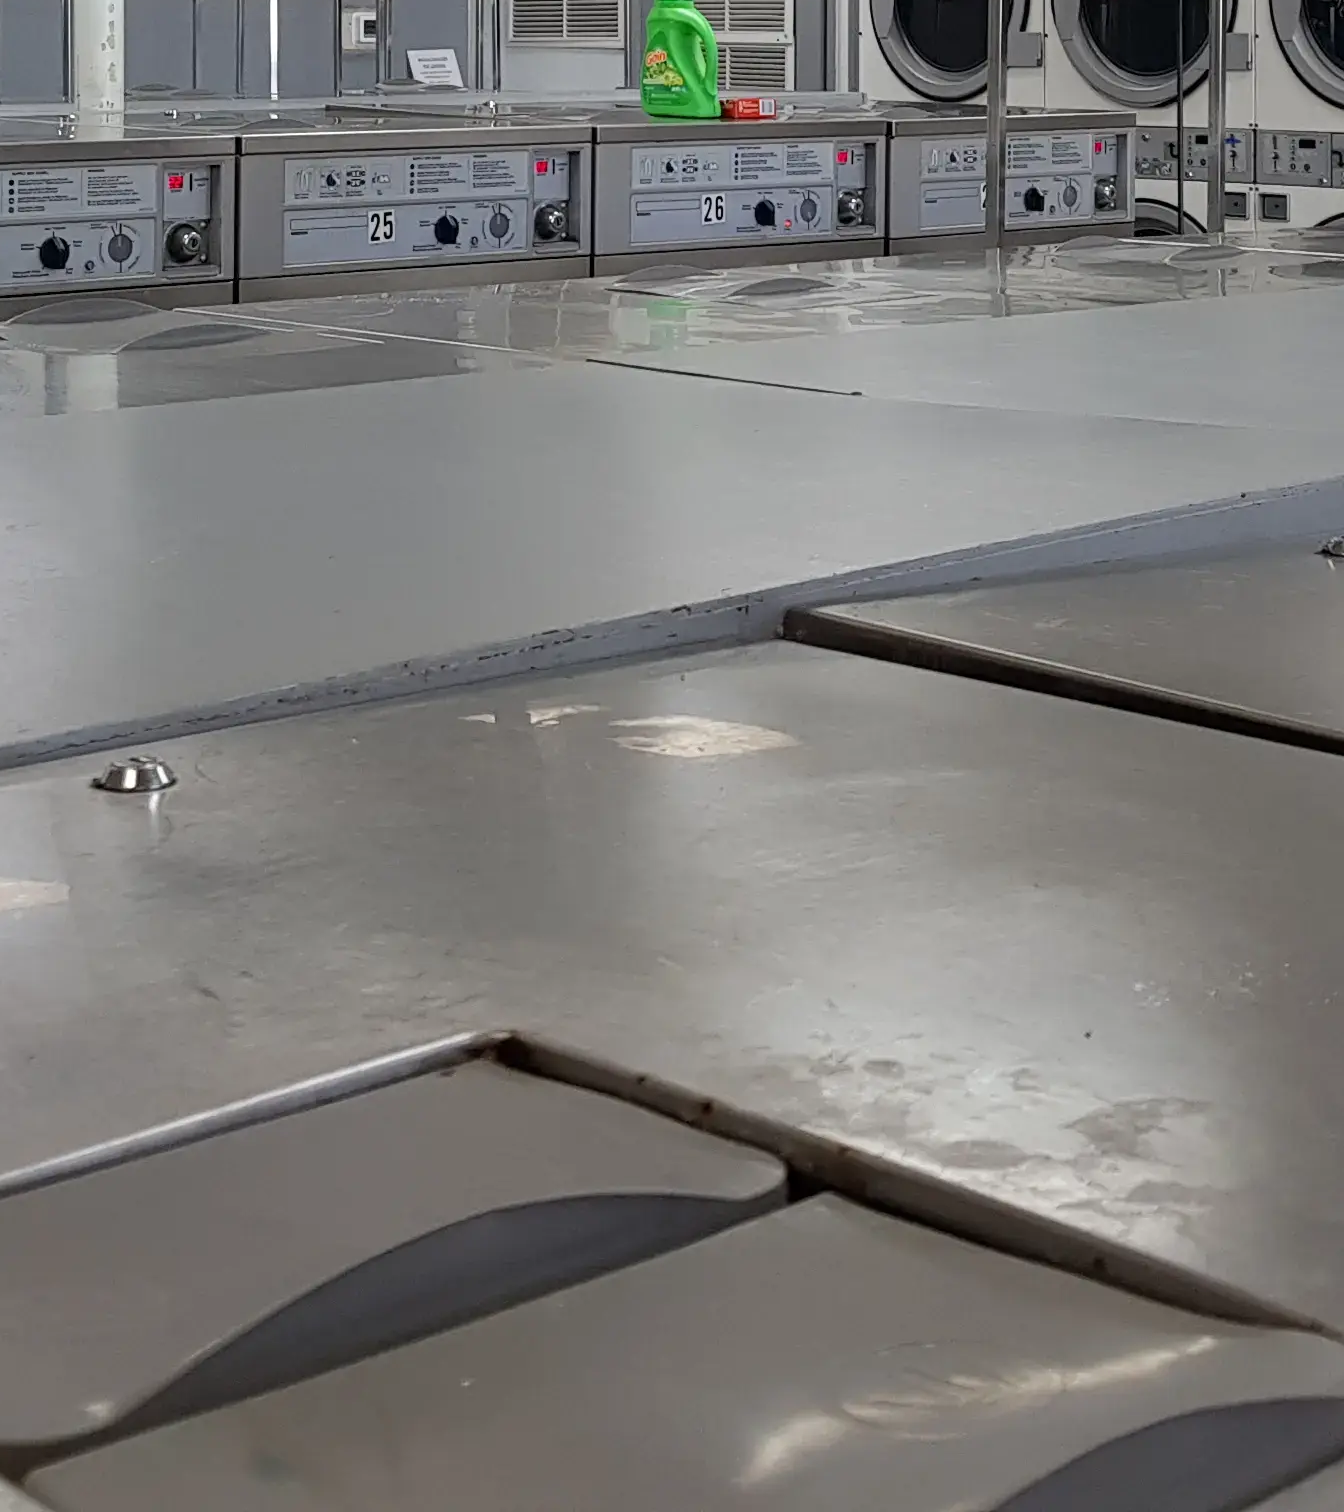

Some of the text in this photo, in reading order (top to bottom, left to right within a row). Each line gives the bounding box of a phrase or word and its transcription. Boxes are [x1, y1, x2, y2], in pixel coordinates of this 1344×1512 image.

[646, 51, 667, 67] Gain
[703, 196, 724, 223] 26
[370, 211, 394, 242] 25
